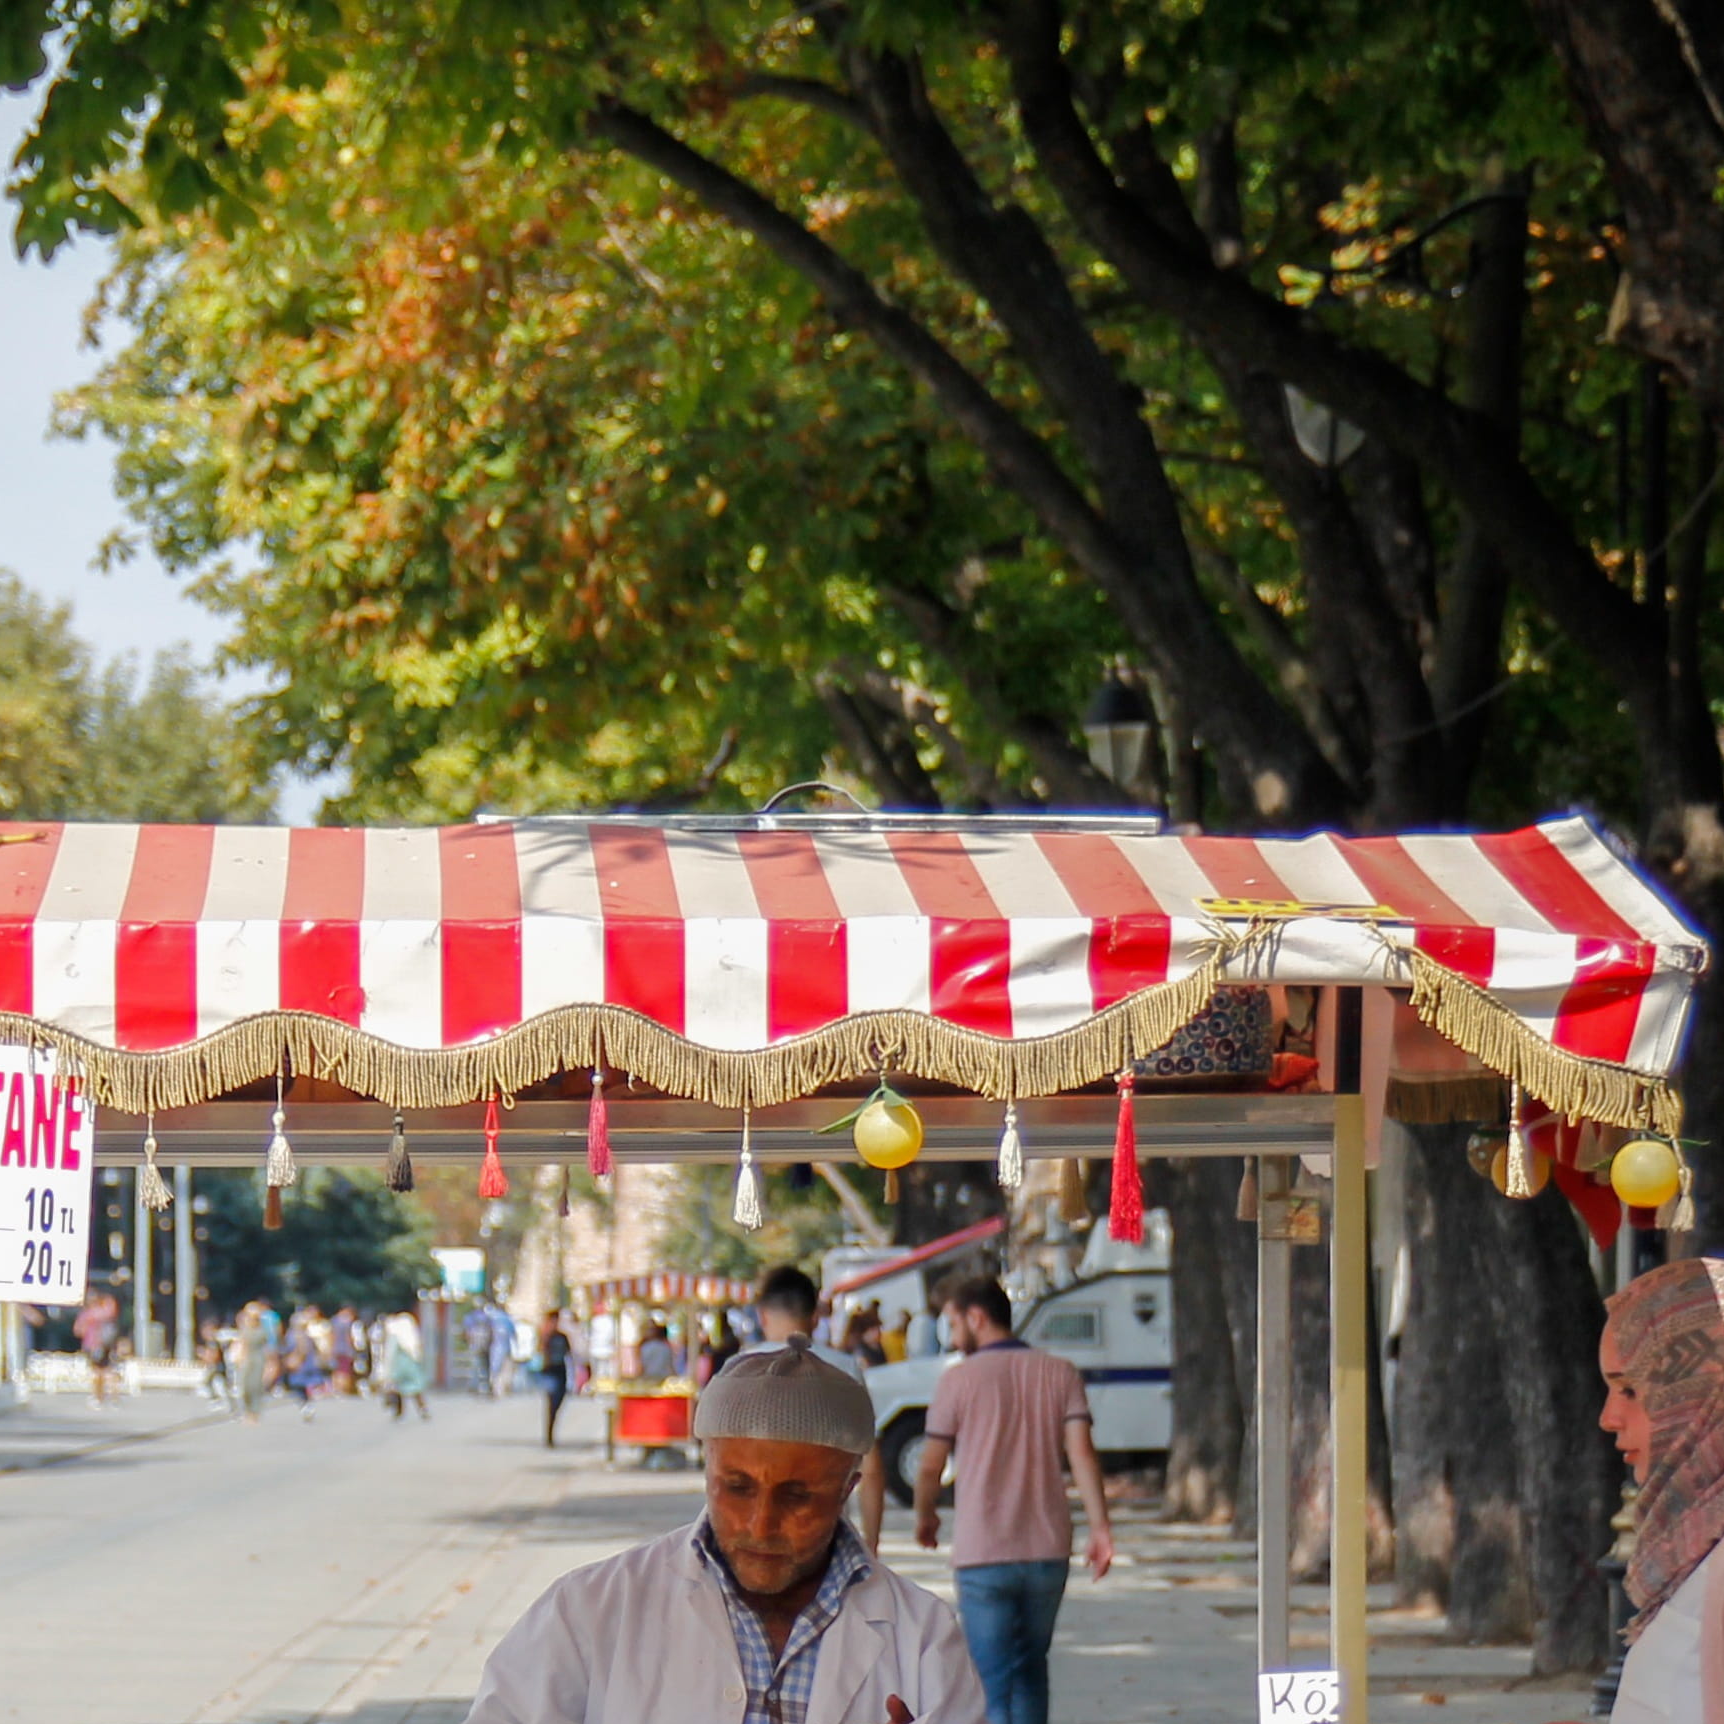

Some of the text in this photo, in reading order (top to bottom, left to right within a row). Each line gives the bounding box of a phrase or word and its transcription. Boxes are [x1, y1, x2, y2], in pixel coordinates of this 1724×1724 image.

[25, 1187, 54, 1233] 10
[60, 1207, 75, 1234] TL
[21, 1240, 53, 1286] 20
[59, 1259, 73, 1287] TL
